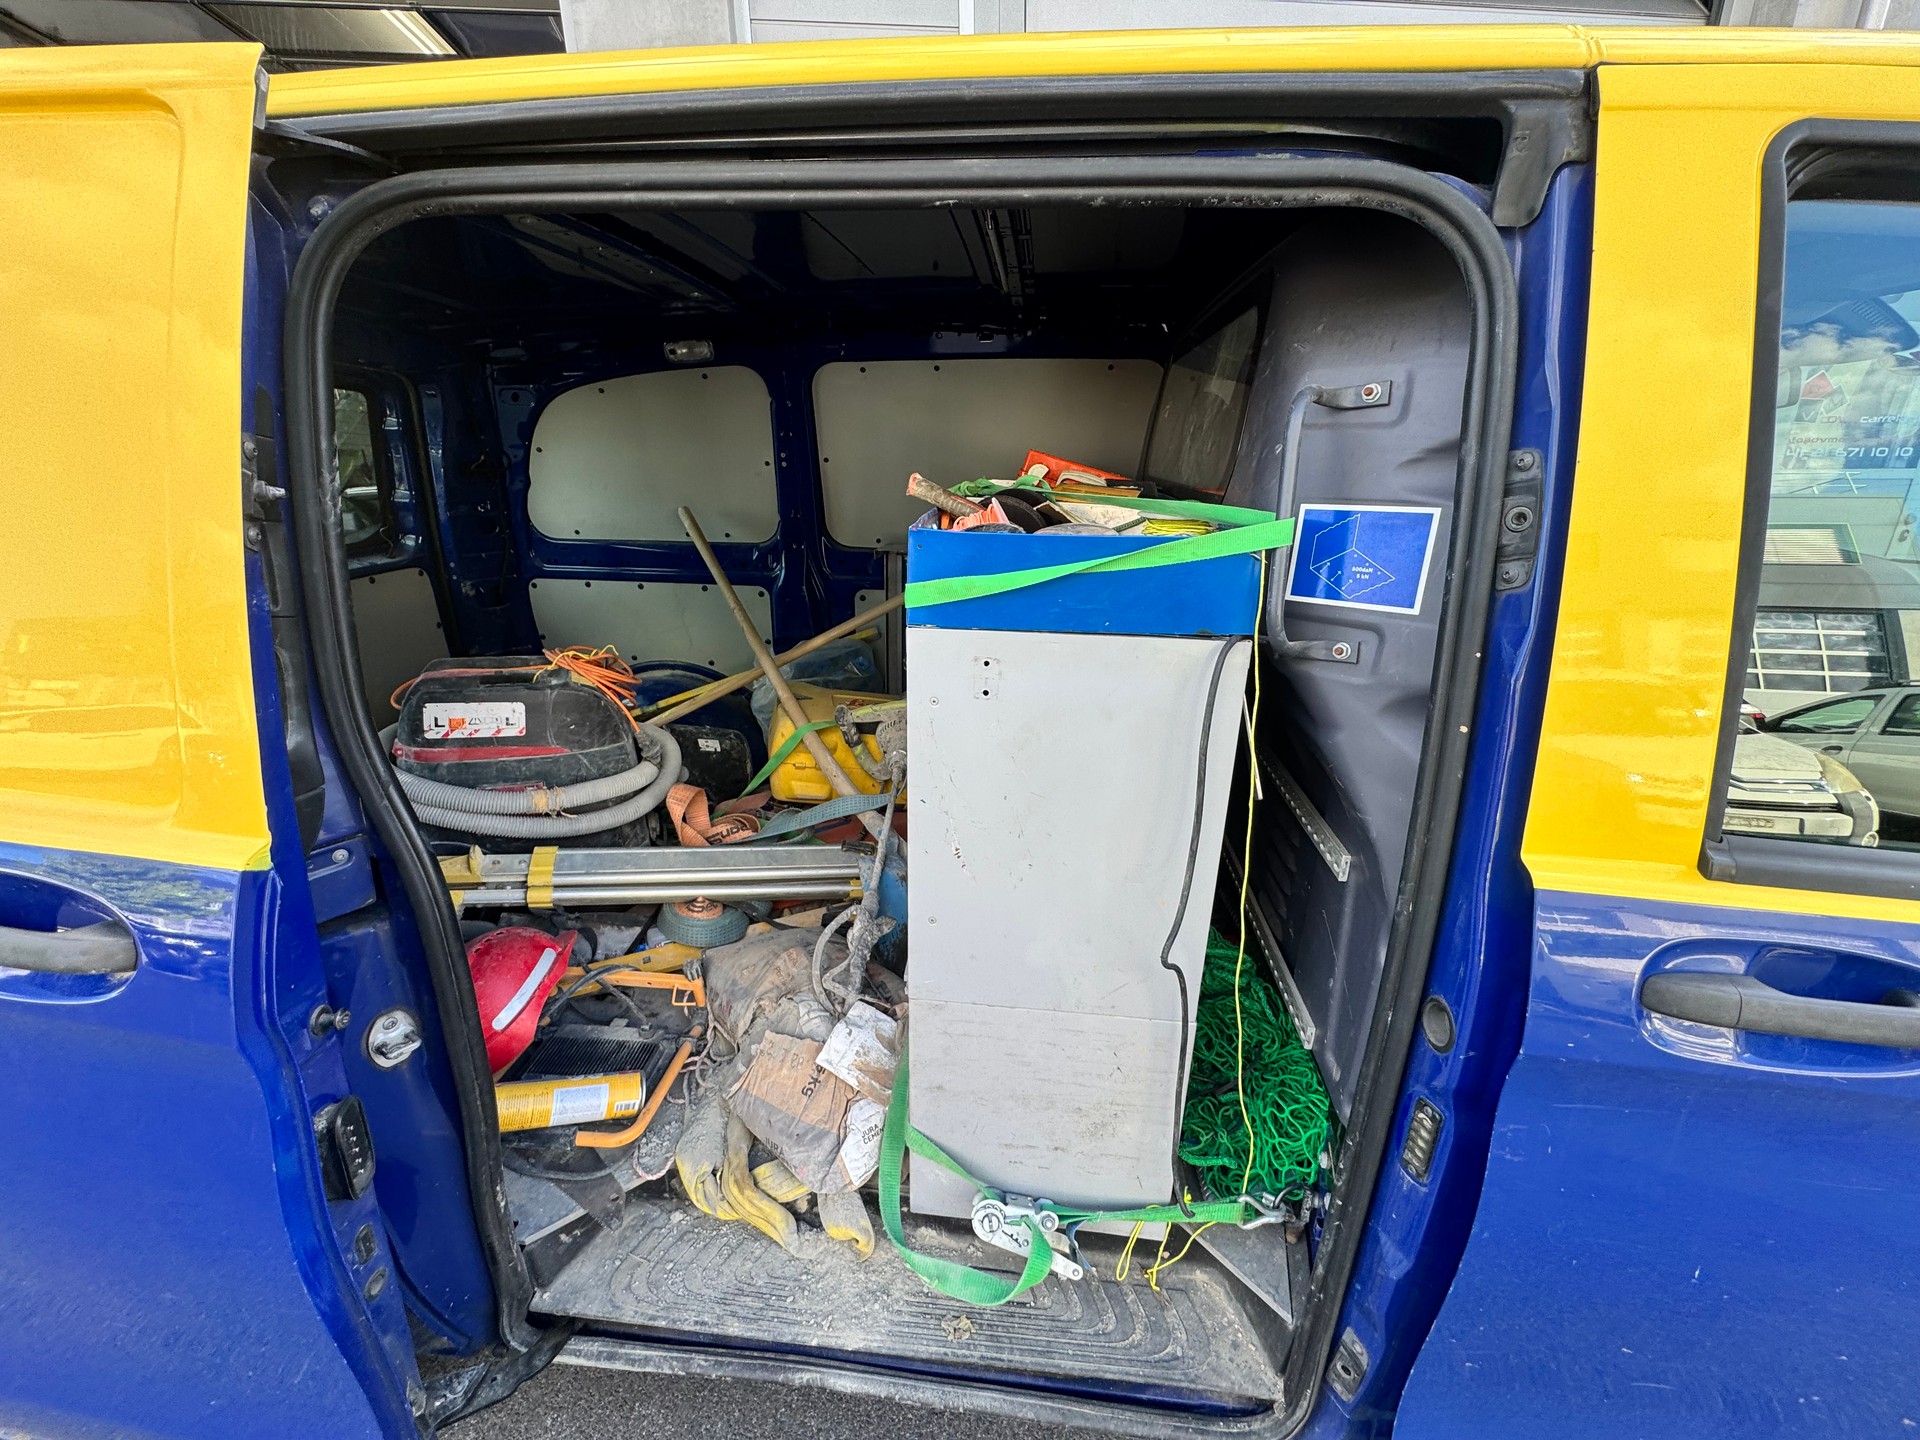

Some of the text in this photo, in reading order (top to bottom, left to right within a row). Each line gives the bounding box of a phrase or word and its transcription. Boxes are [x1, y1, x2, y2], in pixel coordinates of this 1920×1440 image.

[1835, 447, 1865, 458] 671
[1870, 447, 1889, 457] 10
[1895, 446, 1914, 457] 10
[861, 1122, 880, 1139] JURA
[862, 1125, 885, 1146] CEMEN
